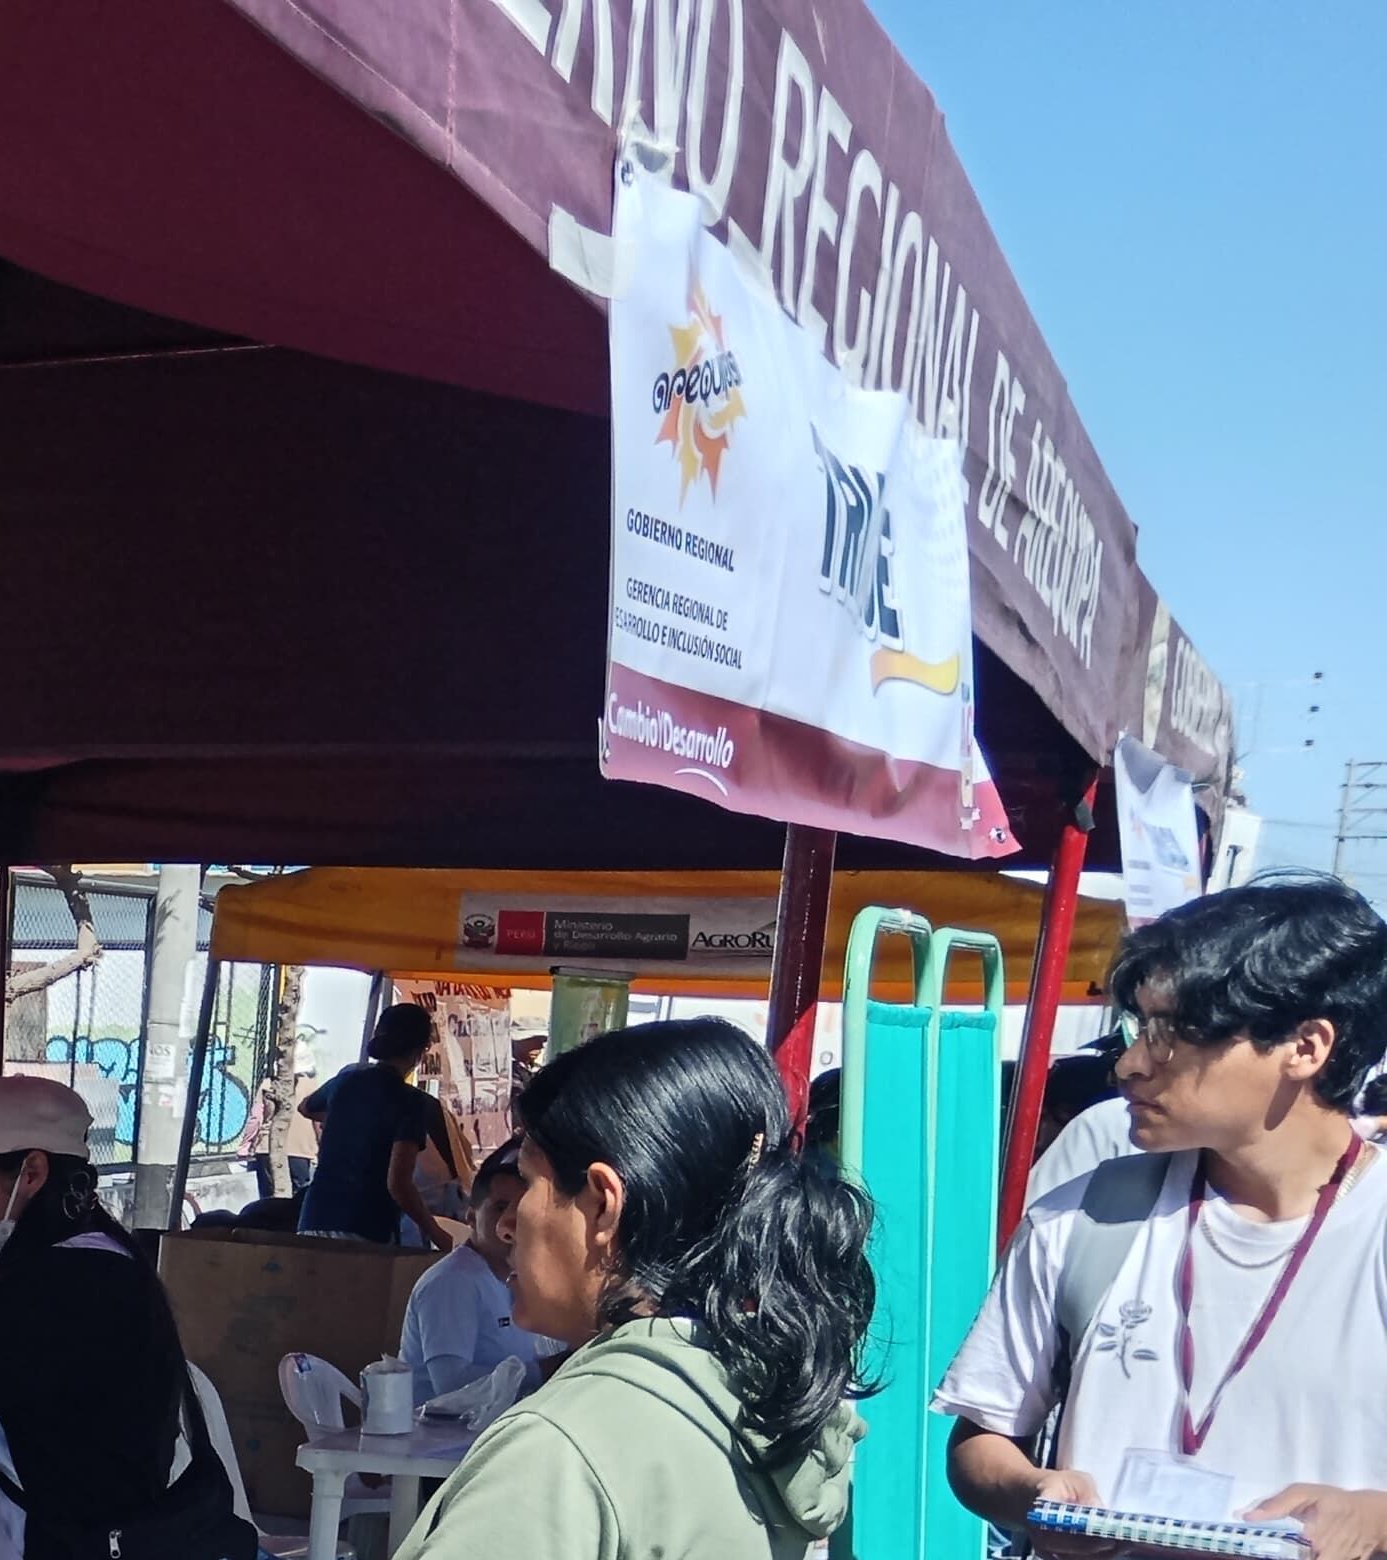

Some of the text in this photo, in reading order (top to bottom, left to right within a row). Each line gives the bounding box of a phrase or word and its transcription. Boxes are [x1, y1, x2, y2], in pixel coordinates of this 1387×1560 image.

[760, 27, 979, 478] REGIONAL
[977, 349, 1027, 552] DE
[626, 508, 735, 572] GOBIERNO REGIONAL
[626, 577, 729, 631] GERENCIA REGIONAL DE
[614, 607, 743, 670] ESARROLLO E INCLUSIÓN SOCIAL
